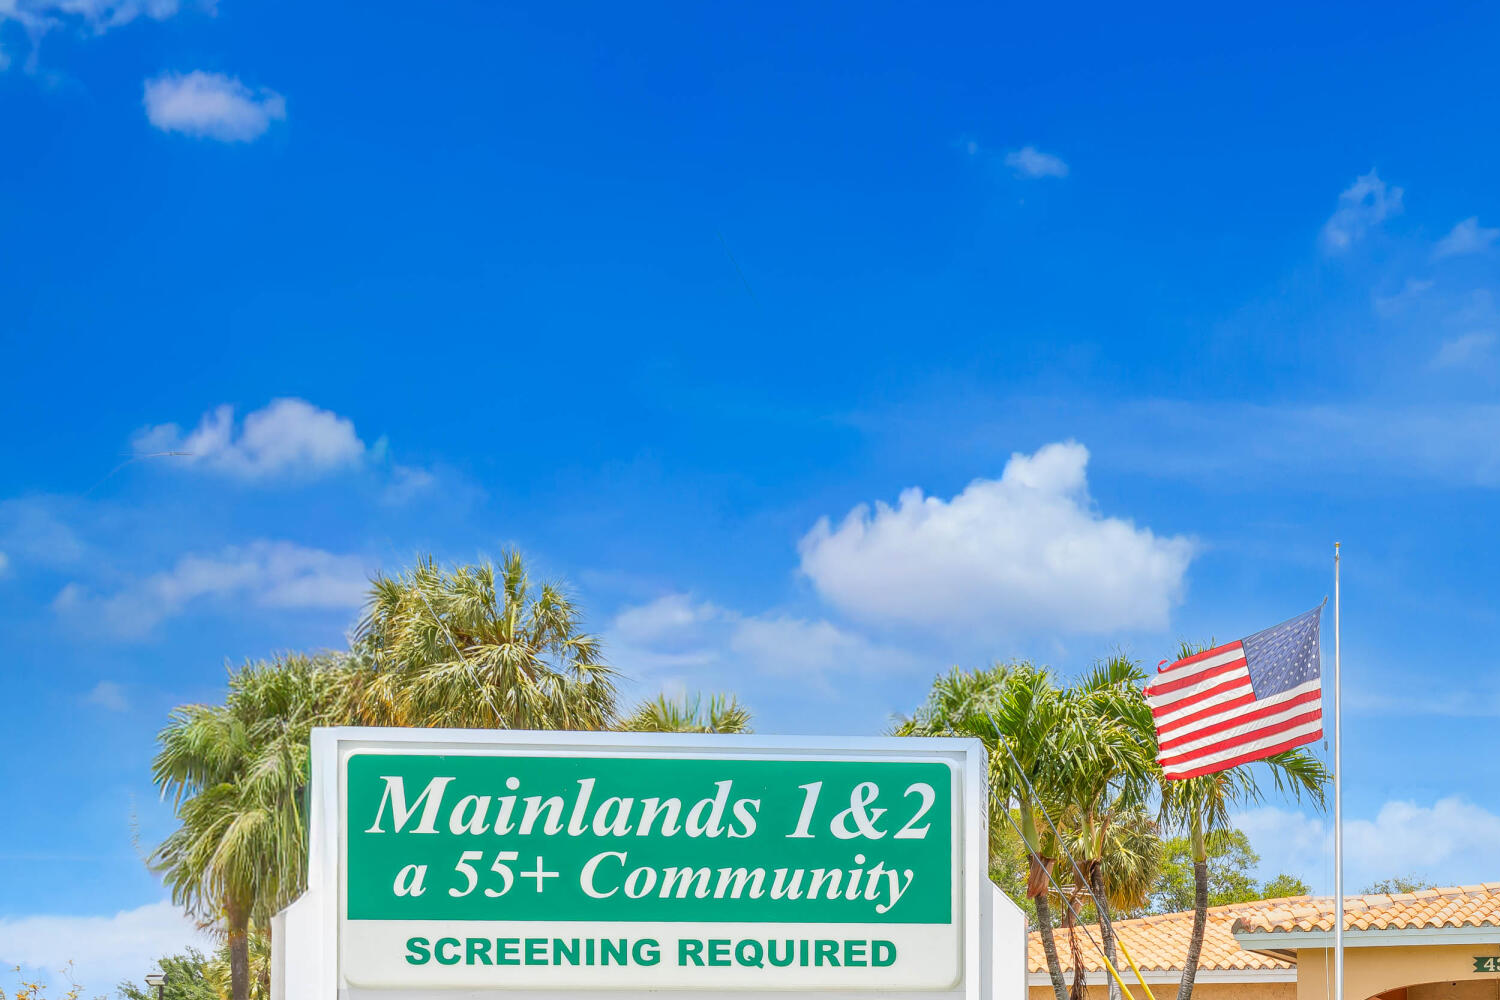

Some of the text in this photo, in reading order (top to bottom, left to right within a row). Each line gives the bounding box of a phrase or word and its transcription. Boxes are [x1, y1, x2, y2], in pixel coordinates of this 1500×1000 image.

[365, 776, 936, 840] Mainlands 1&2
[393, 850, 914, 914] a 55+ Community
[404, 936, 897, 969] SCREENING REQUIRED
